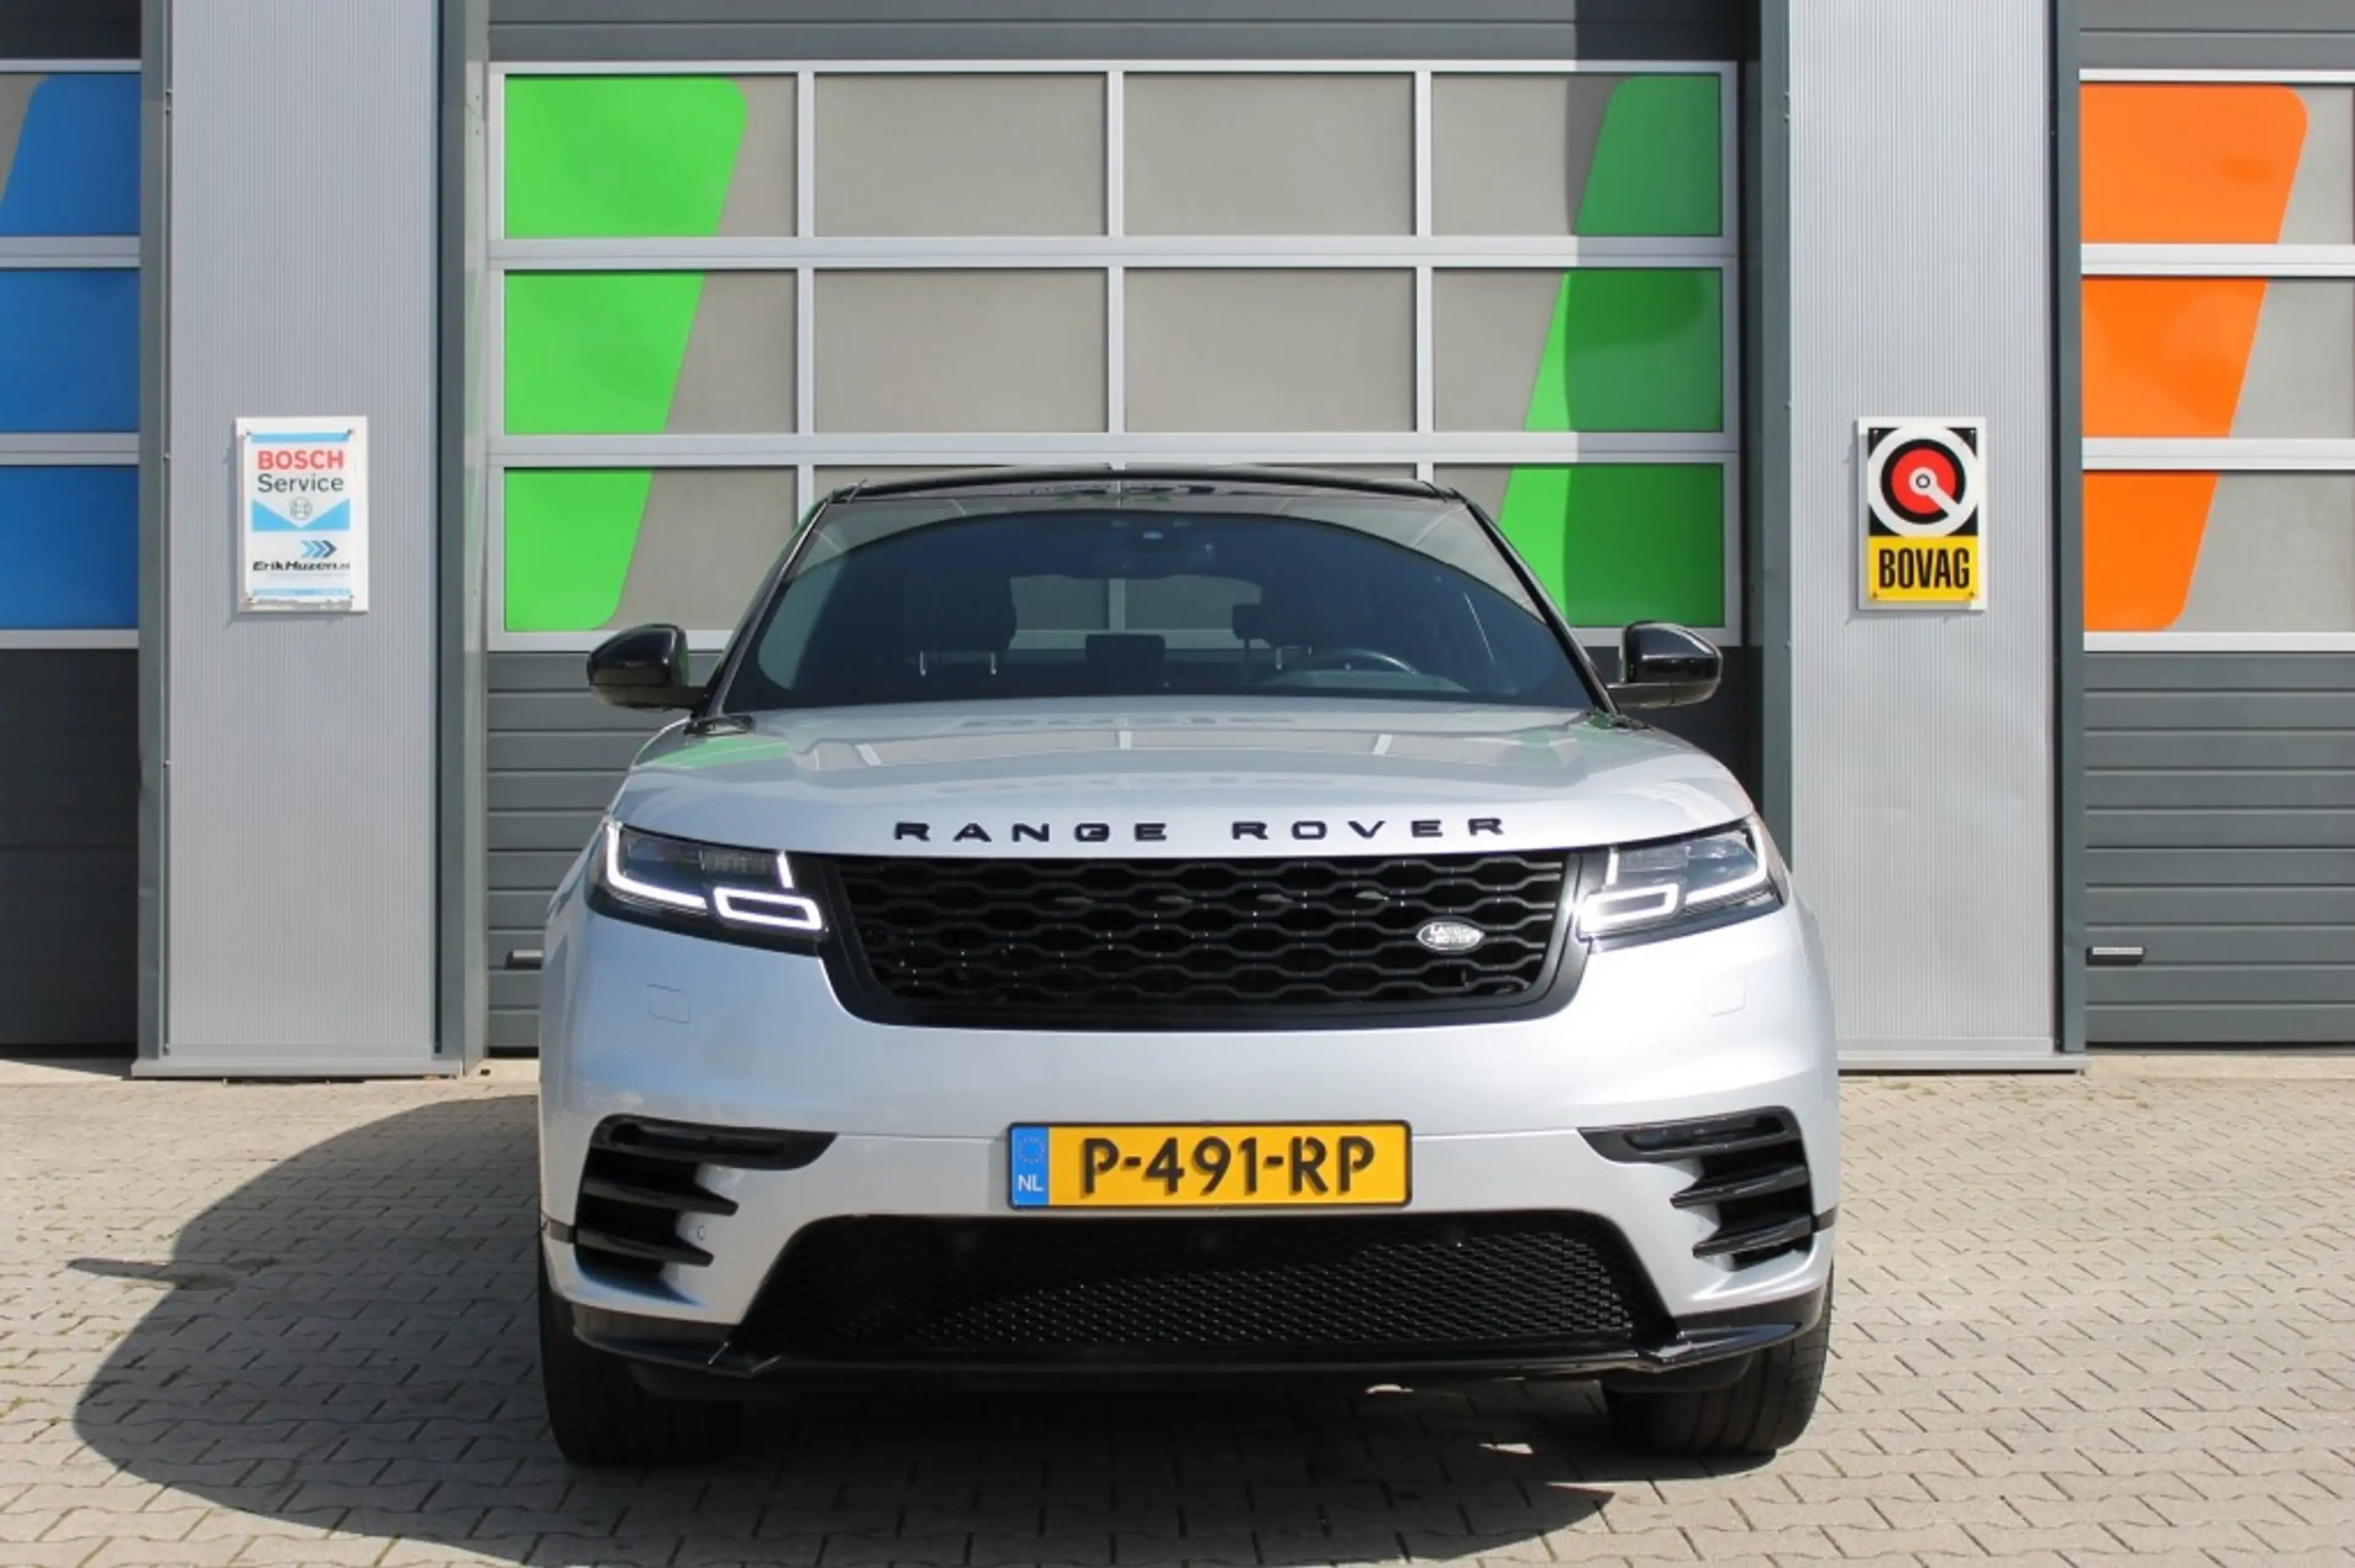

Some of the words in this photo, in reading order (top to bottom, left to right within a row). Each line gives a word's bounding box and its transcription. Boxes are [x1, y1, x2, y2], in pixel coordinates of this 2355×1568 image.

[257, 449, 344, 470] BOSCH
[257, 473, 344, 493] Service
[1878, 548, 1970, 589] BOVAG
[894, 822, 1167, 843] RANGE
[1231, 818, 1504, 840] ROVER
[1081, 1136, 1376, 1196] P-491-RP
[1017, 1174, 1043, 1191] NL
